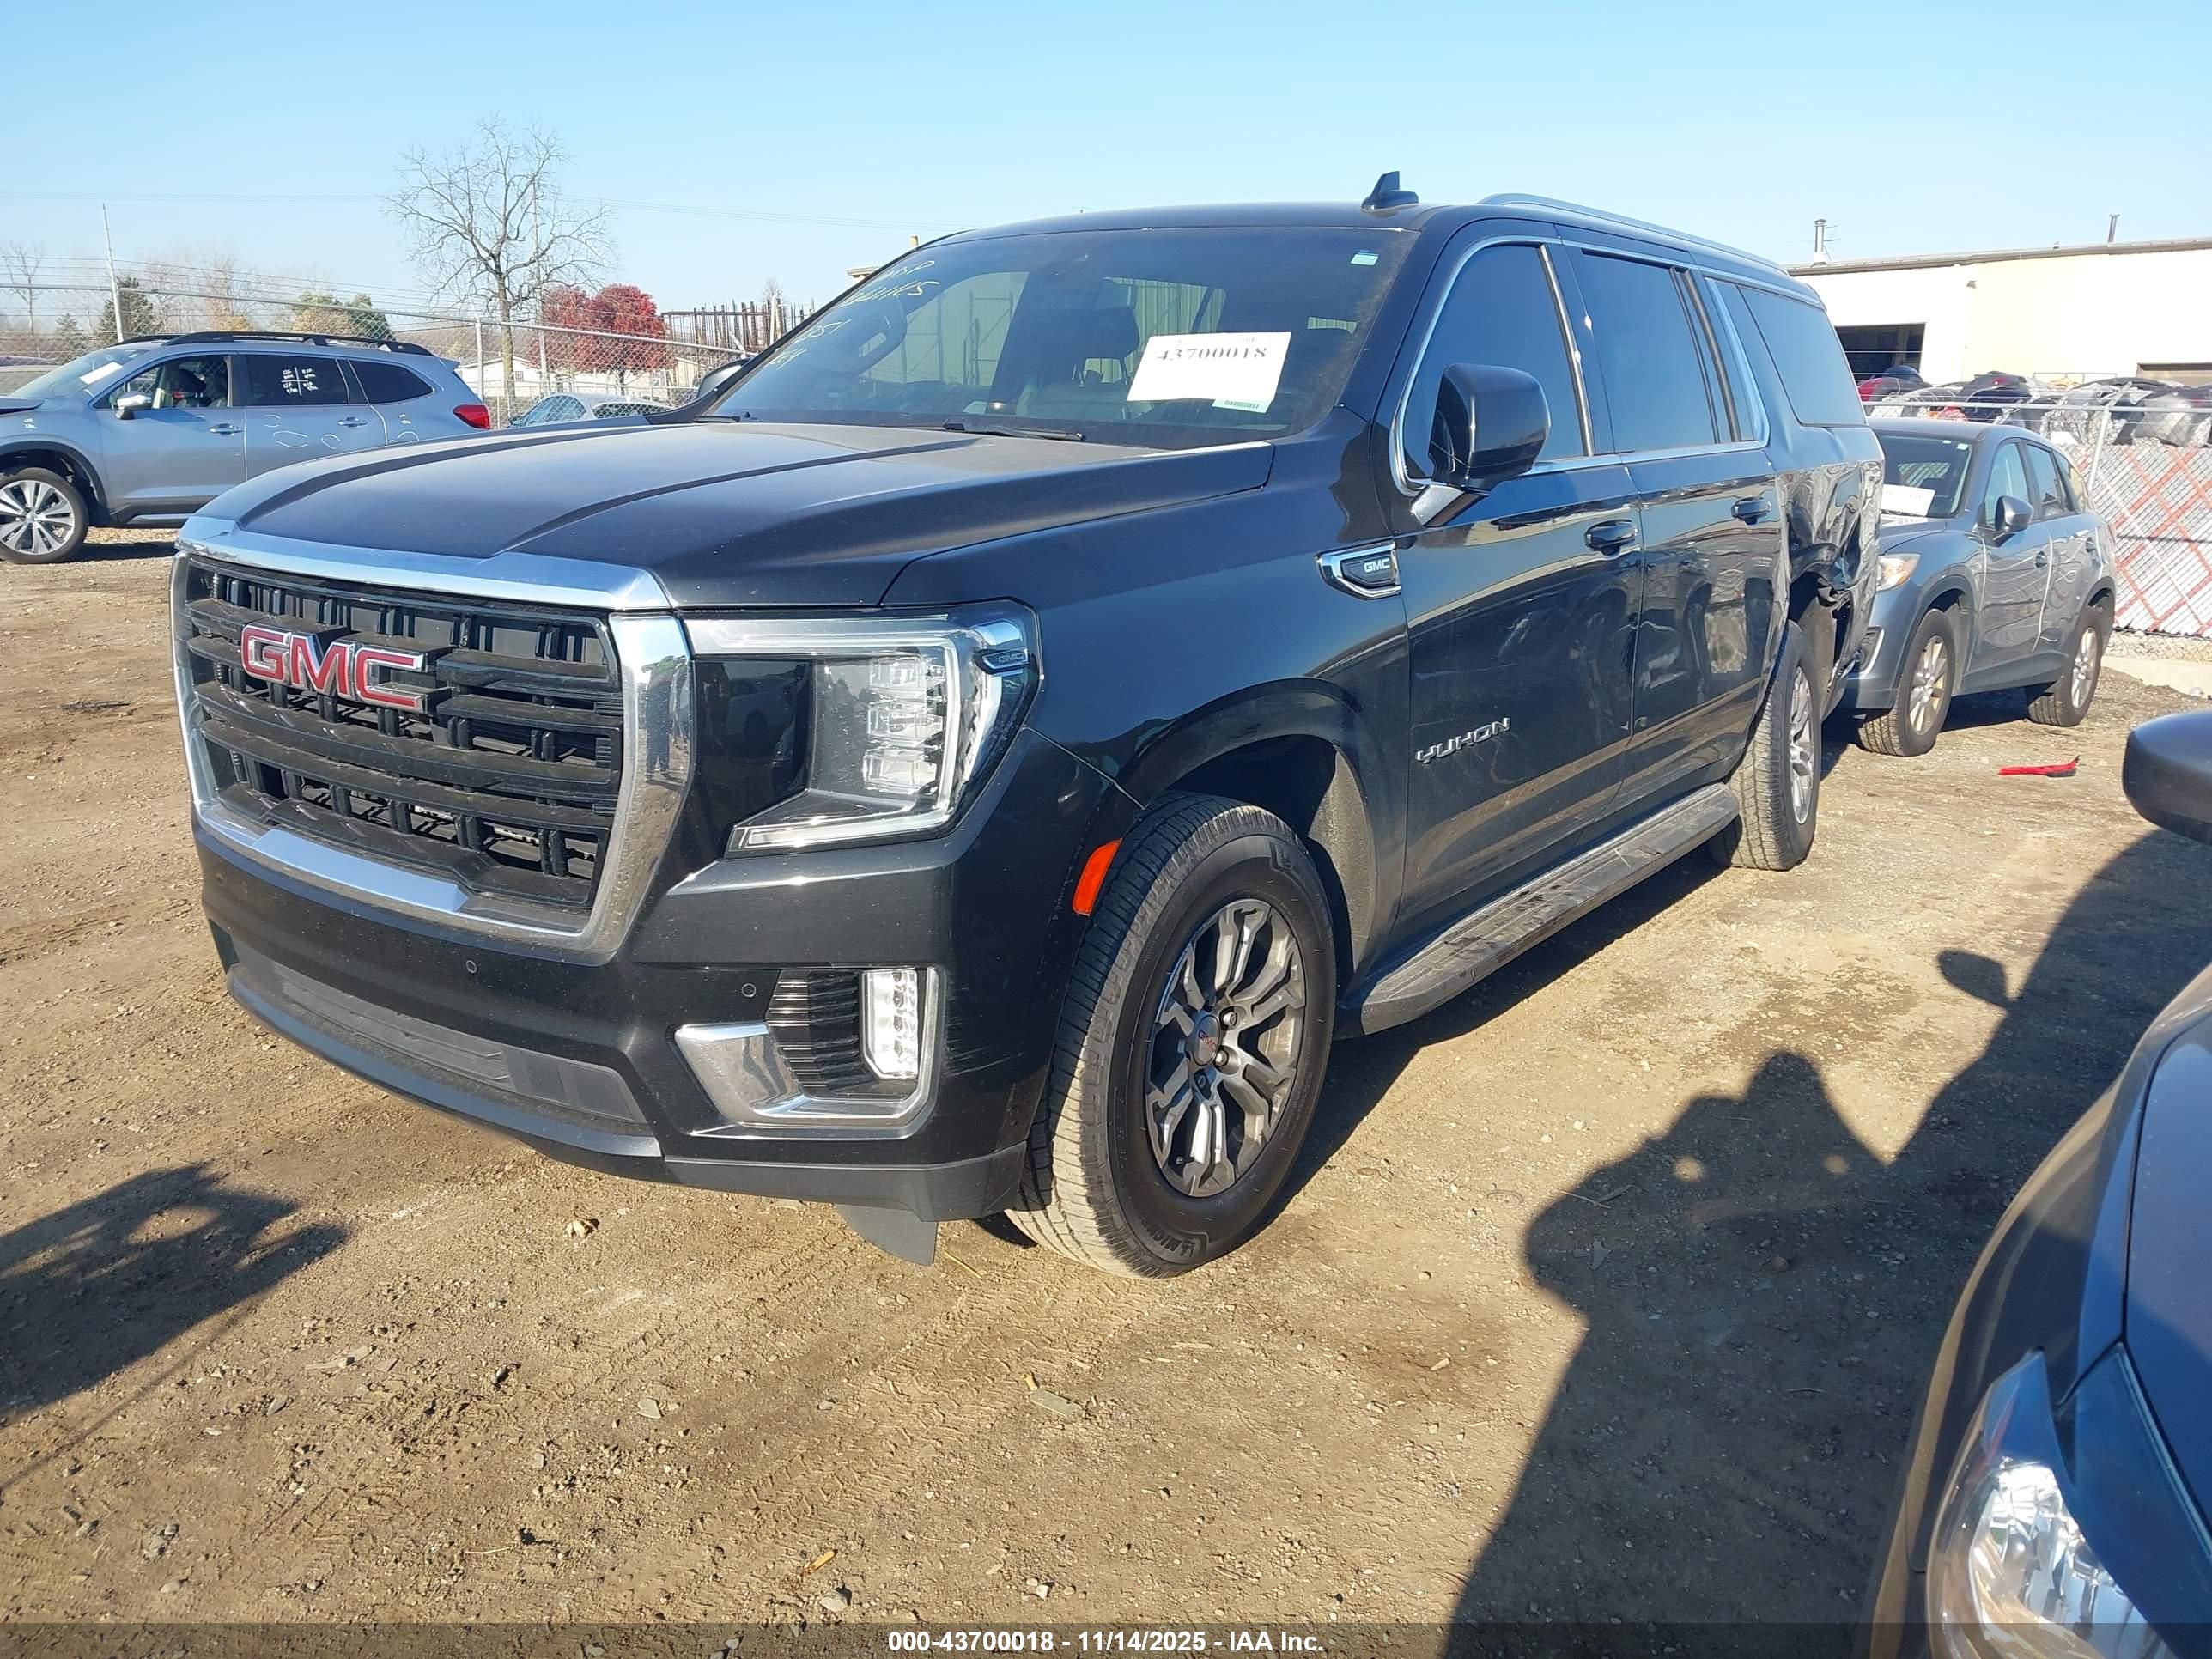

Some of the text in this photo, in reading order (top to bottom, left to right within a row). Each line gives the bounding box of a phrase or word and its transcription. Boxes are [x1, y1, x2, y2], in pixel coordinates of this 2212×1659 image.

[1157, 347, 1268, 361] 43700018
[1364, 558, 1390, 573] GMC
[998, 652, 1024, 663] GMC
[240, 623, 426, 714] GMC
[1415, 717, 1511, 764] YUKON
